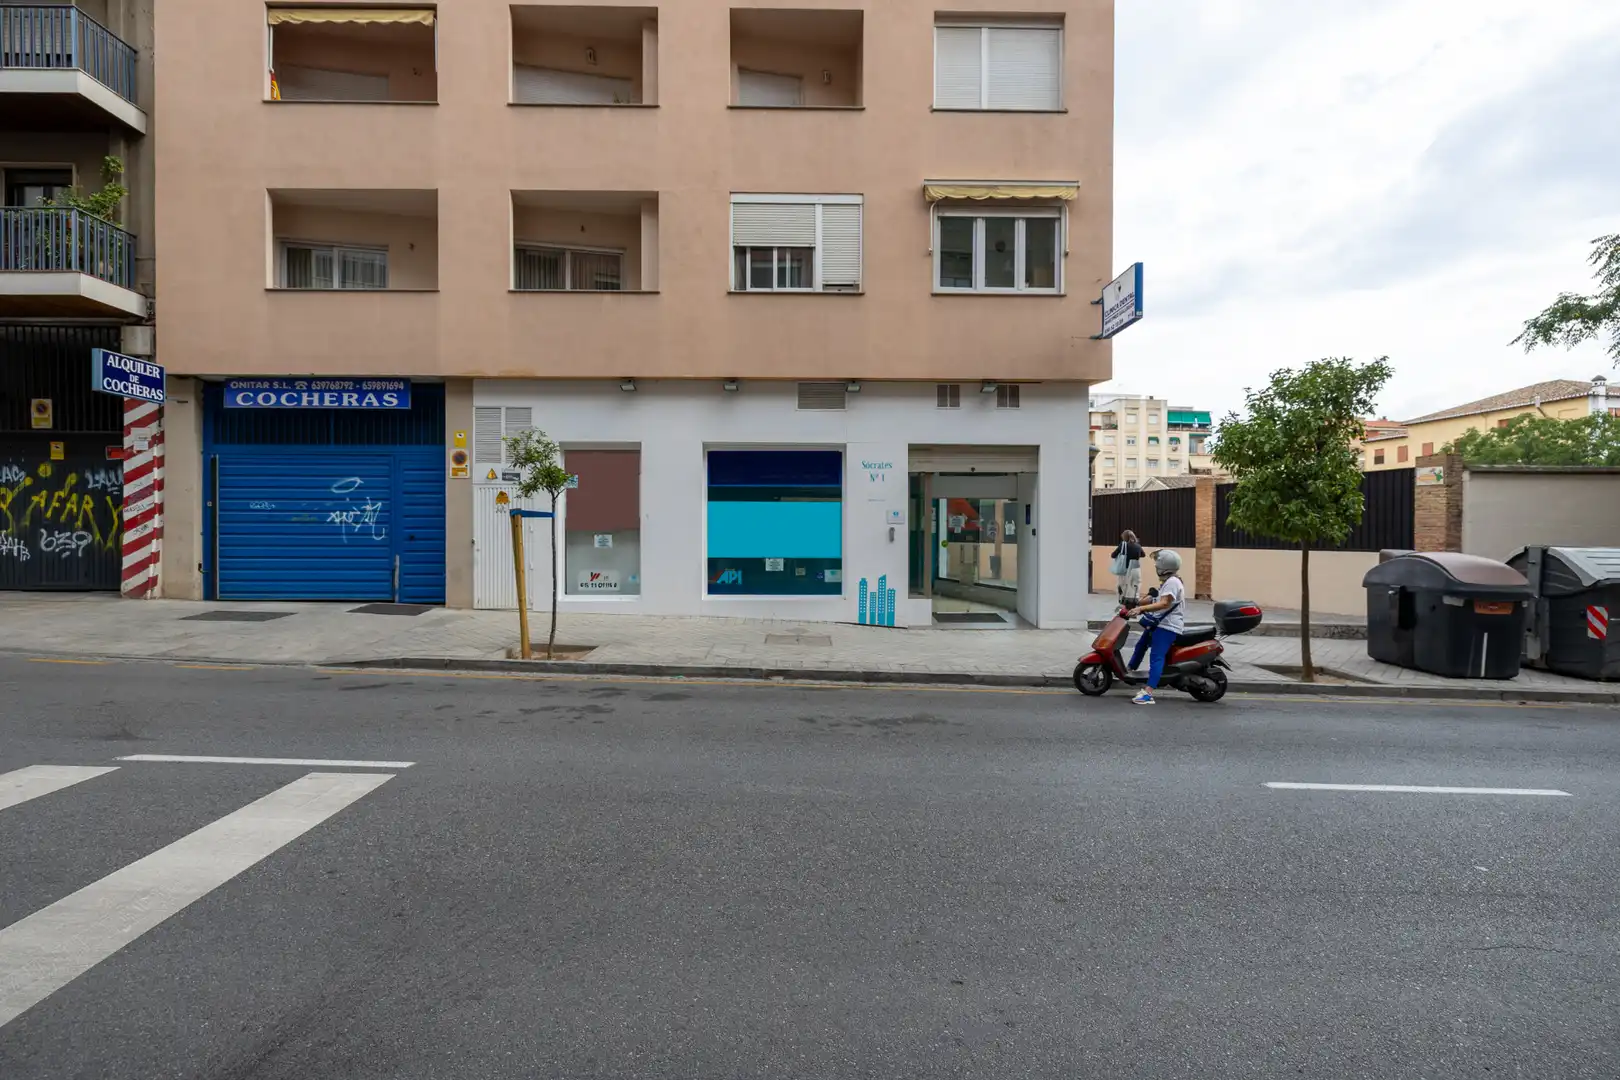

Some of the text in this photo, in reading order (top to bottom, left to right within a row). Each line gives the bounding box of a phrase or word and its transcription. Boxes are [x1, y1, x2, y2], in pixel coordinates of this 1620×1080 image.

[107, 354, 160, 378] ALQUILER
[130, 374, 140, 384] DE
[230, 381, 270, 390] ONITAR
[272, 381, 291, 390] S.L.
[104, 378, 163, 400] COCHERAS
[236, 392, 399, 406] COCHERAS
